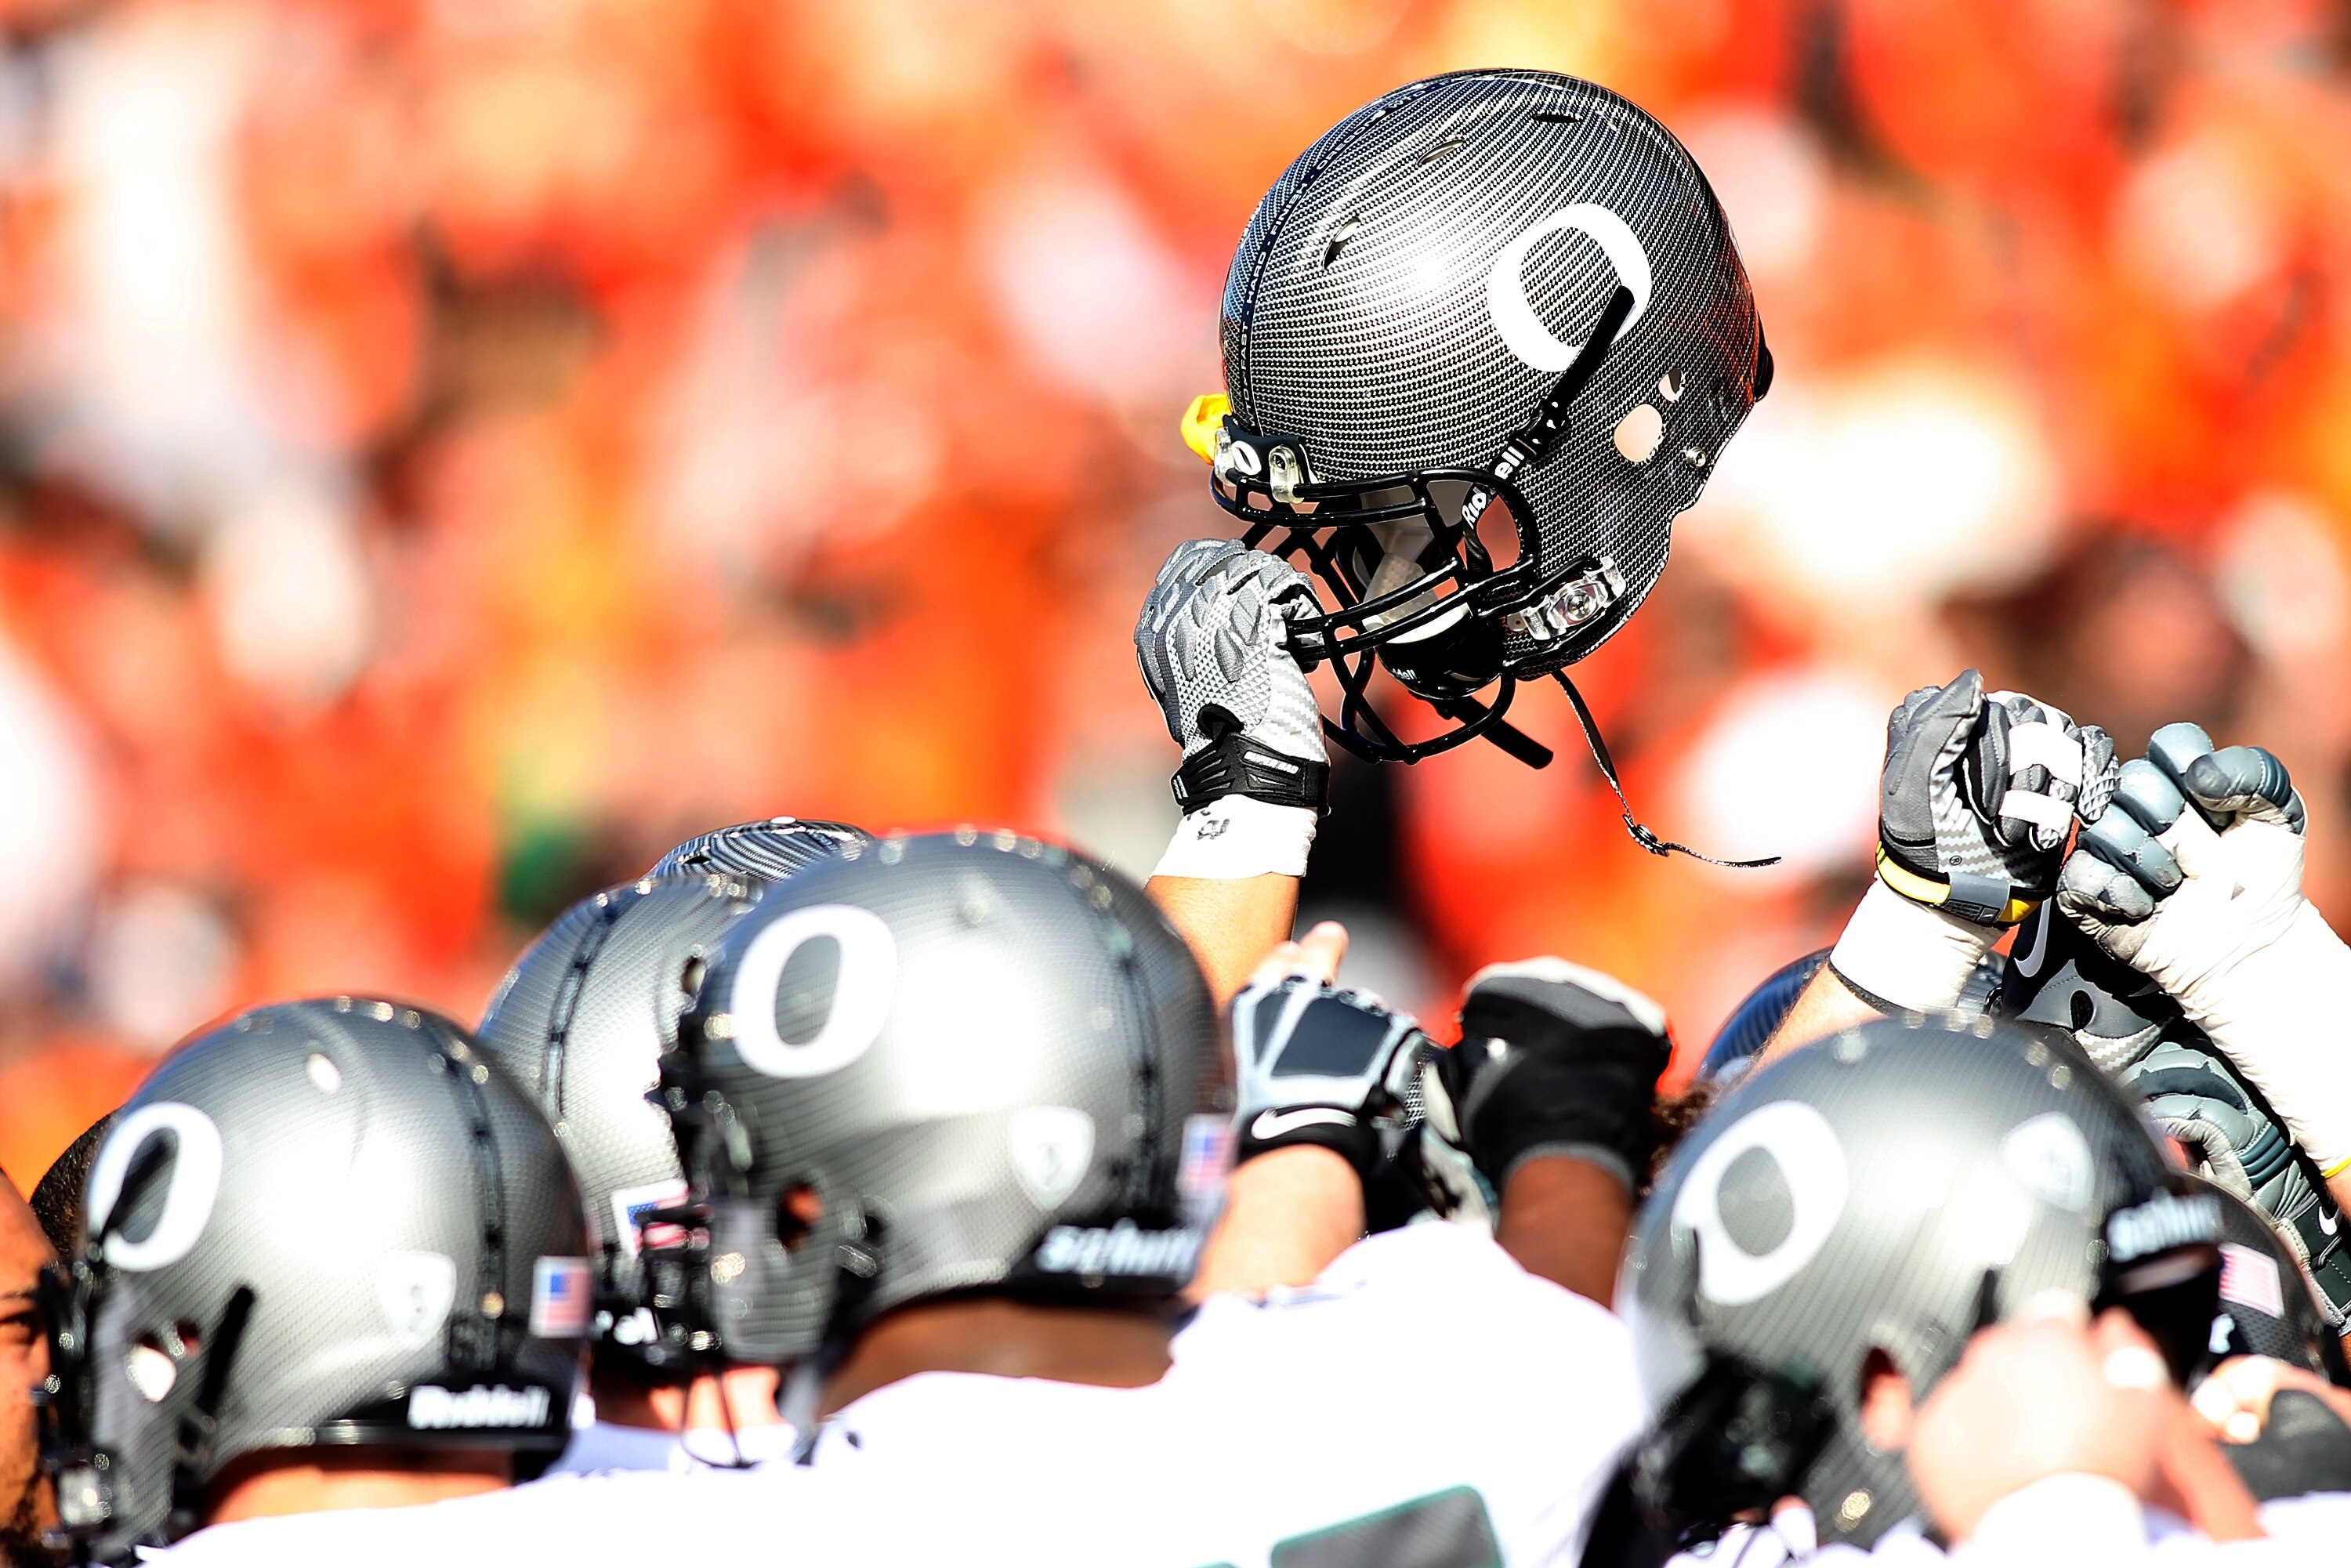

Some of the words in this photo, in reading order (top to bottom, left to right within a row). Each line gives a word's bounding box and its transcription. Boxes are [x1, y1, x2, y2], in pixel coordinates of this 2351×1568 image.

[1246, 252, 1266, 304] HARD
[1270, 183, 1308, 236] FINISH
[1316, 115, 1377, 171] OREGON
[1487, 202, 1652, 372] O
[1244, 750, 1278, 769] SUPER
[1277, 760, 1300, 774] BAD
[731, 904, 897, 1078] O
[86, 1103, 223, 1271] O
[1672, 1100, 1848, 1305] O
